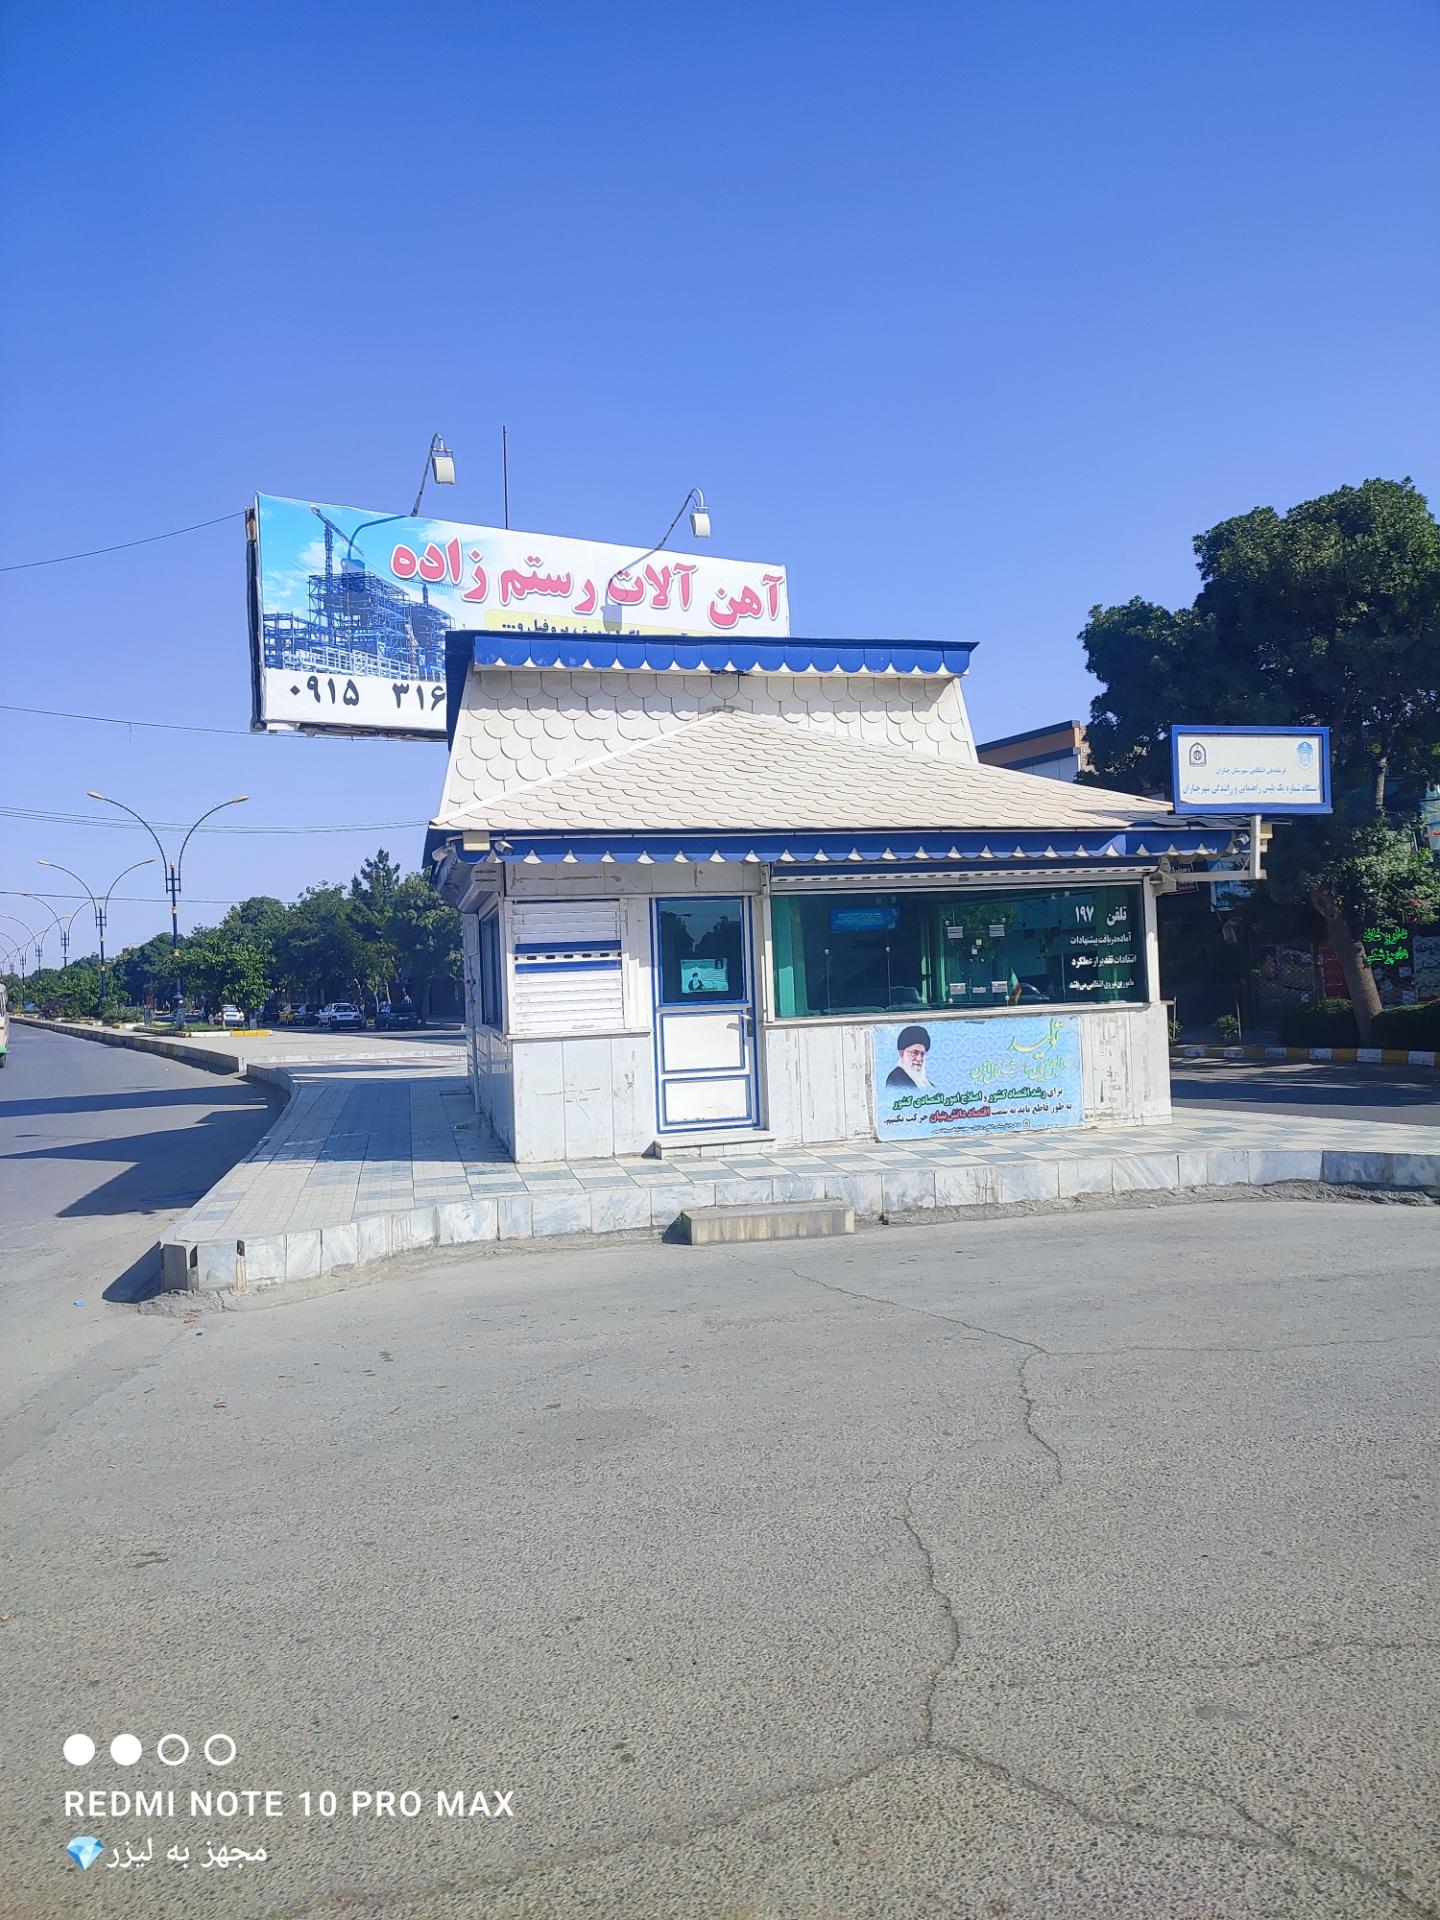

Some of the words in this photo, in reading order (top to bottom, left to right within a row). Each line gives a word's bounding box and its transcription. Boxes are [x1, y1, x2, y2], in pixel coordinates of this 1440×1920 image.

[390, 536, 488, 604] زاده
[498, 554, 597, 615] رستم
[606, 562, 699, 611] آلات
[708, 574, 786, 629] آهن
[289, 675, 360, 707] ۰۹۱۵
[391, 682, 446, 712] ۳۱۶
[1075, 904, 1095, 923] ۱۹۷
[1106, 905, 1128, 926] تلفن
[912, 1092, 944, 1108] اقتصادی
[944, 1092, 961, 1107] امور
[961, 1090, 983, 1105] اصلاح
[988, 1088, 1007, 1104] کشور
[1007, 1086, 1031, 1100] اقتصاد
[1031, 1086, 1047, 1100] رشد
[1047, 1086, 1063, 1098] برای
[892, 1095, 913, 1110] کشور
[905, 1113, 928, 1124] حرکت
[967, 1105, 991, 1118] اقتصاد
